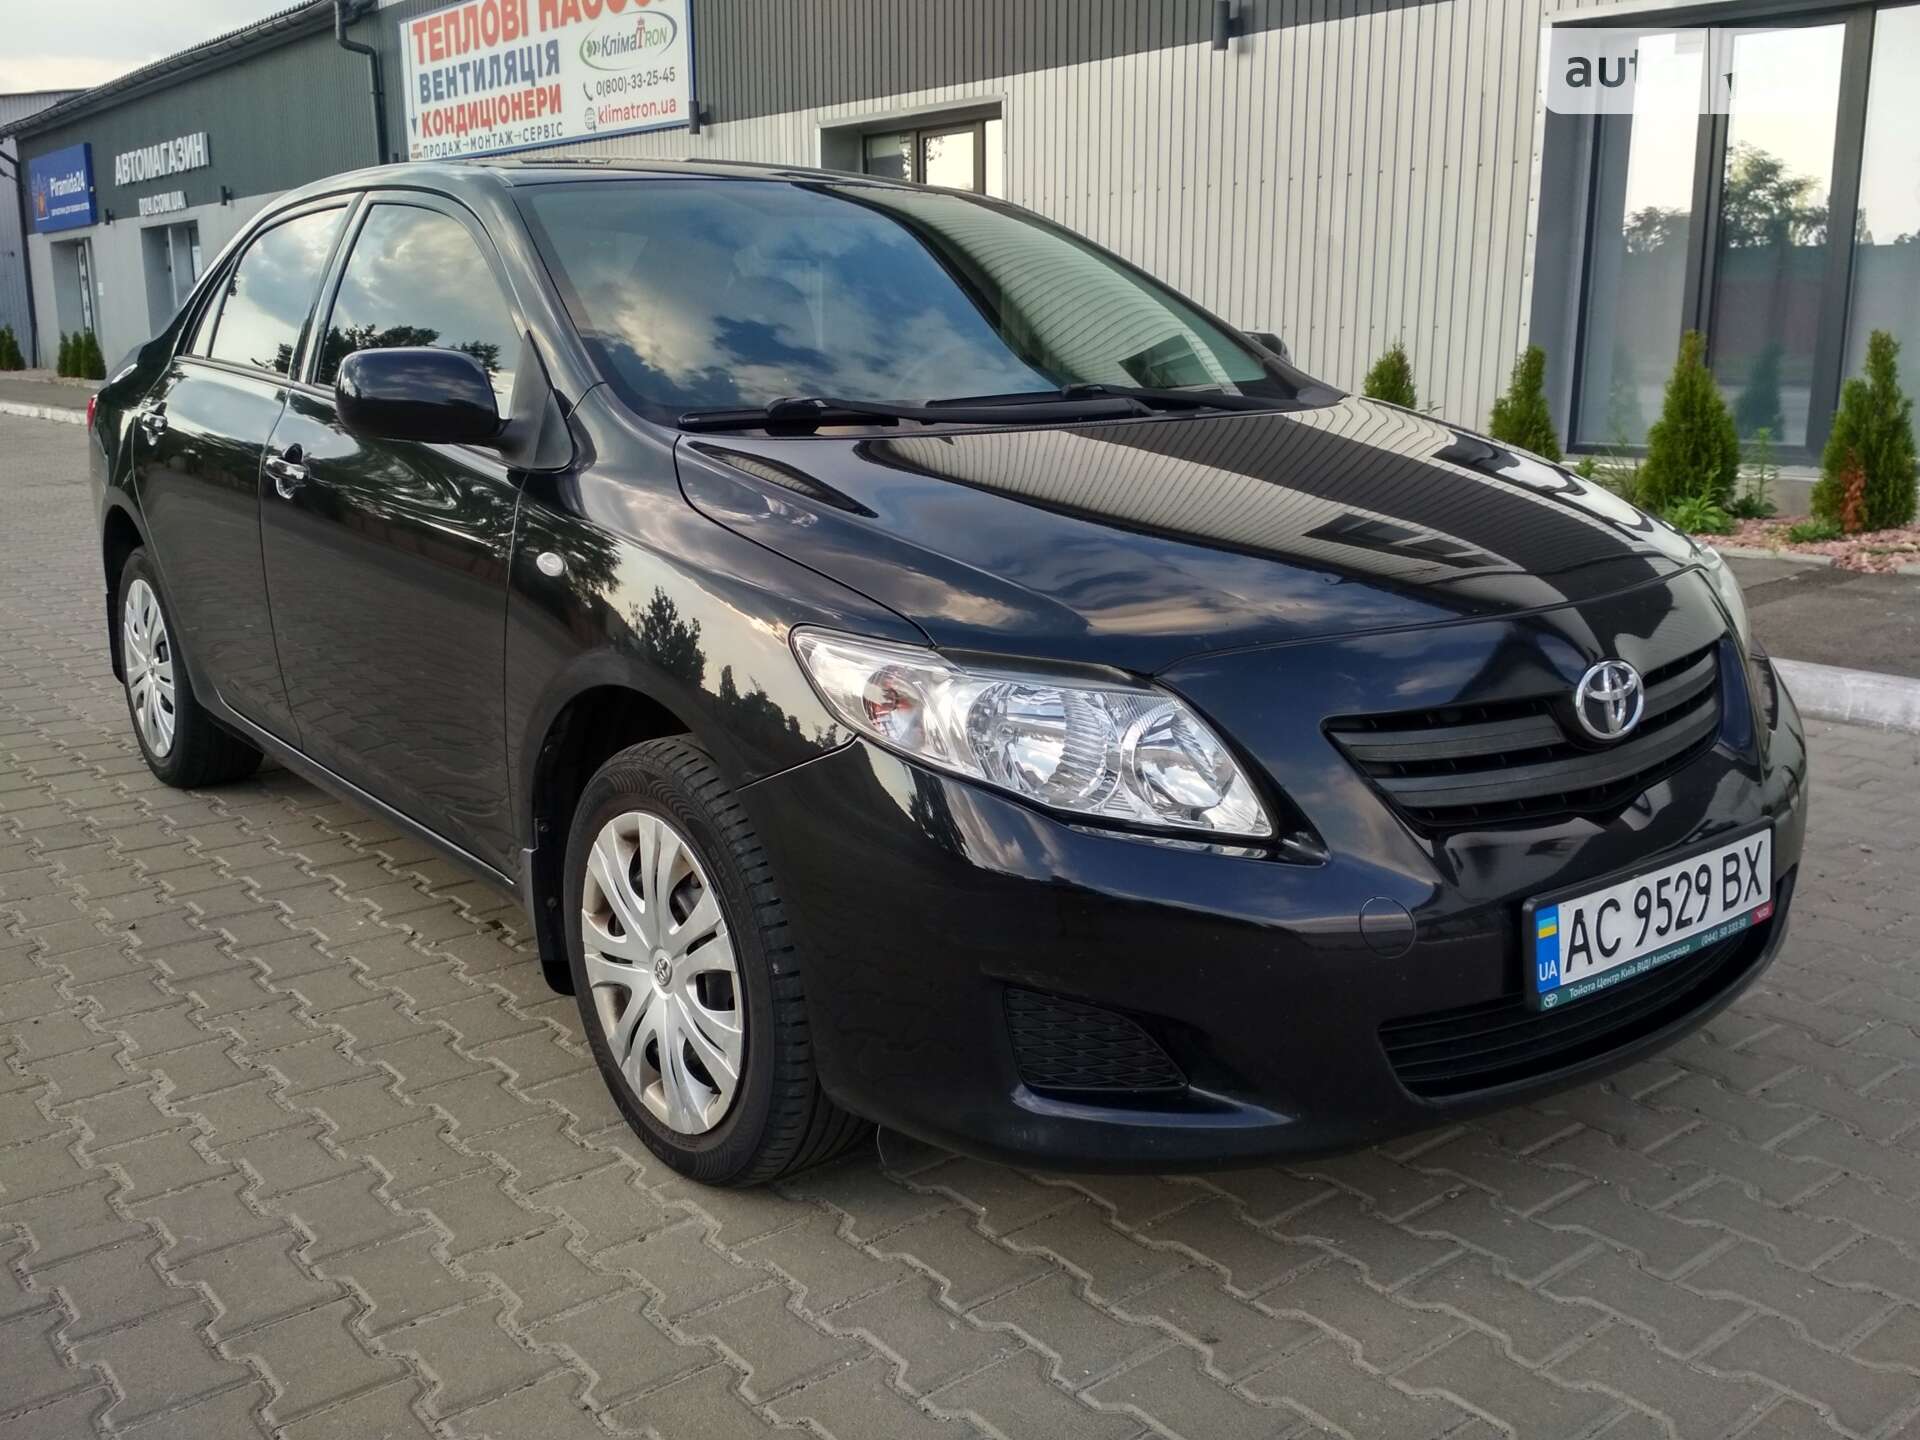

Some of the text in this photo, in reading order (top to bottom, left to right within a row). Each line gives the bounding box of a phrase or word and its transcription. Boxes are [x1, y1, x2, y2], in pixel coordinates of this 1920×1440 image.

[412, 0, 529, 65] ТЕПЛОВІ
[419, 39, 560, 104] ВЕНТИЛЯЦІЯ
[595, 66, 676, 97] 0(800)-33-25-45
[421, 83, 562, 138] КОНДИЦІОНЕРИ
[597, 97, 677, 125] klimatron.ua
[115, 132, 208, 187] АВТОМАГАЗИН
[423, 139, 461, 159] ПРОДАЖ
[470, 127, 513, 151] МОНТАЖ
[522, 121, 564, 143] СЕРВІС
[1565, 840, 1763, 974] AC 9529 BX
[1539, 959, 1558, 982] UA
